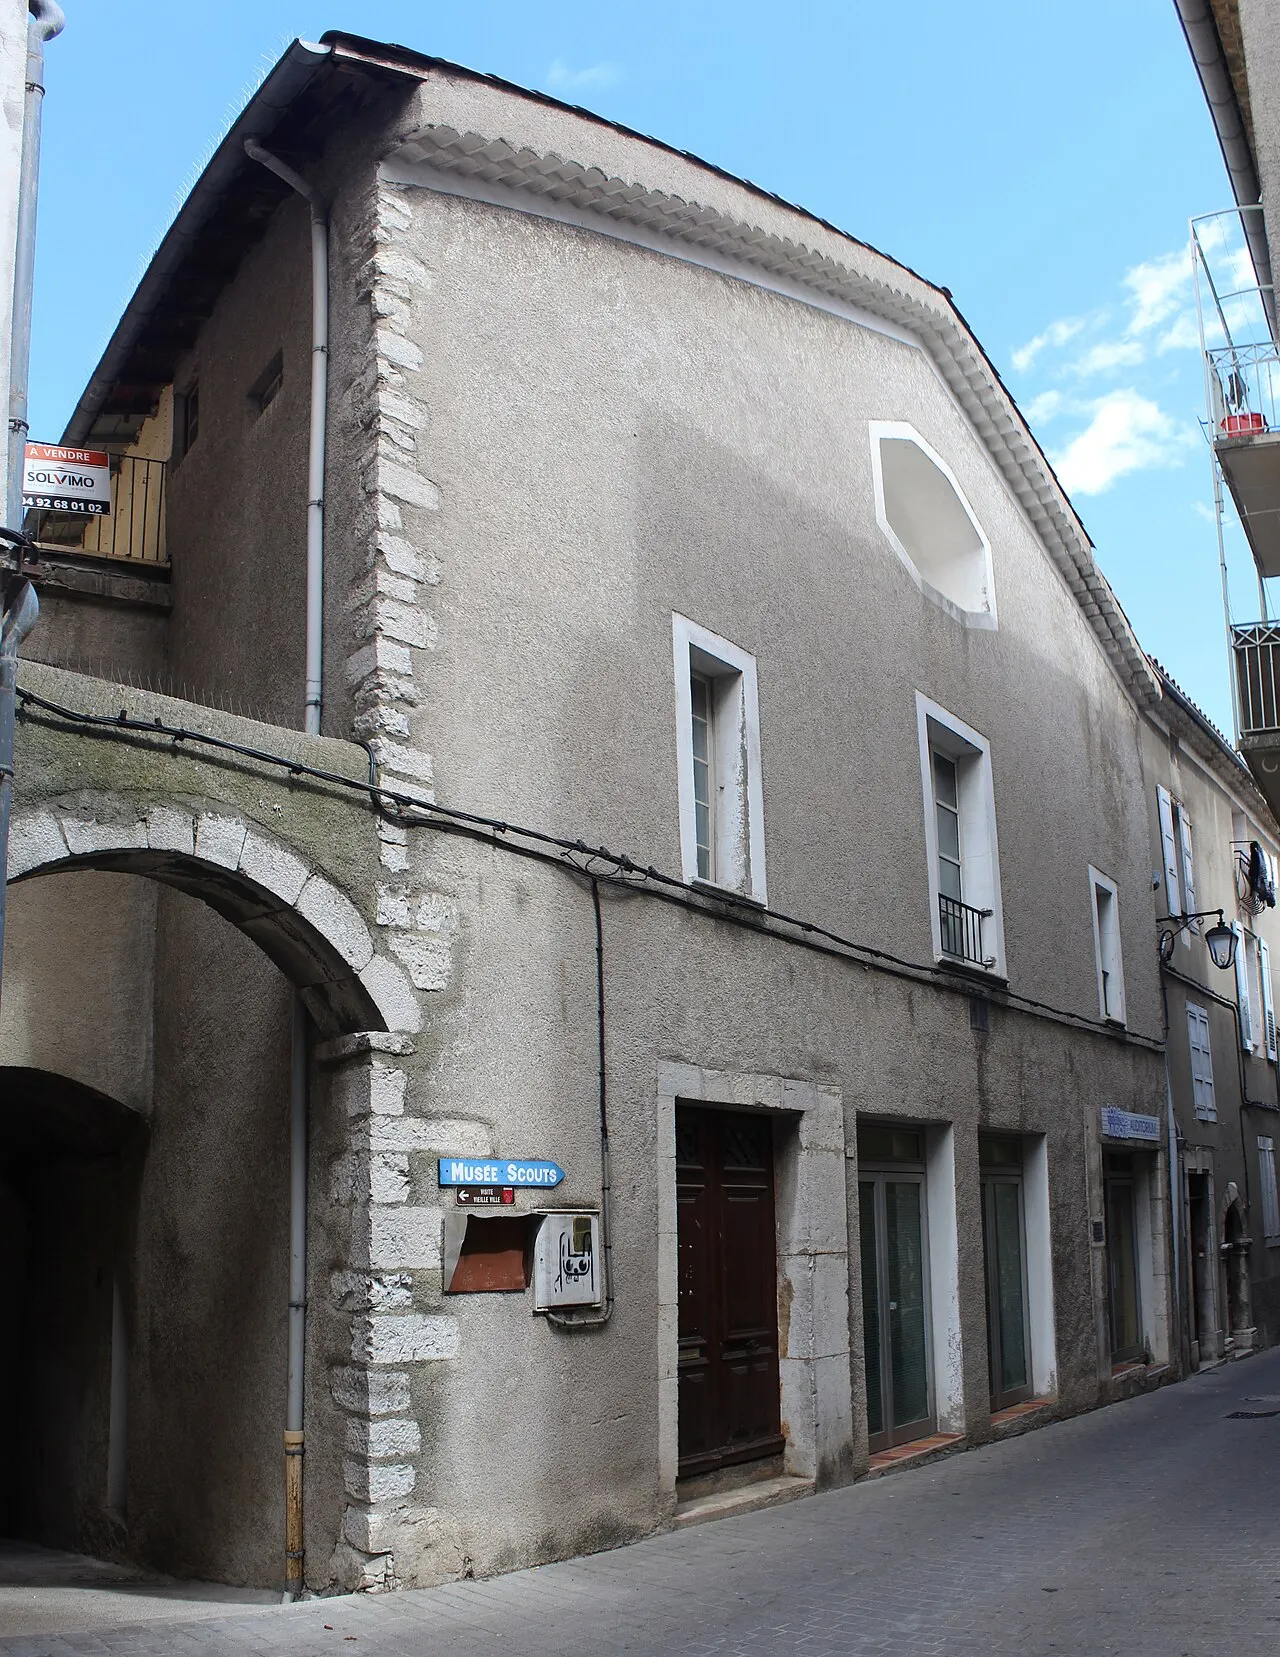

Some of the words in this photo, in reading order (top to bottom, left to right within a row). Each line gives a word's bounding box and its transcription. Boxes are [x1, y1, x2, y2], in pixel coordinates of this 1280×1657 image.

[29, 447, 39, 456] A
[43, 448, 90, 461] VENDRE
[27, 471, 95, 488] SOLVIMO
[36, 498, 52, 508] 92
[54, 499, 68, 509] 68
[71, 501, 85, 511] 01
[88, 503, 103, 513] 02
[451, 1162, 498, 1182] MUSÉE
[507, 1163, 557, 1183] SCOUTS
